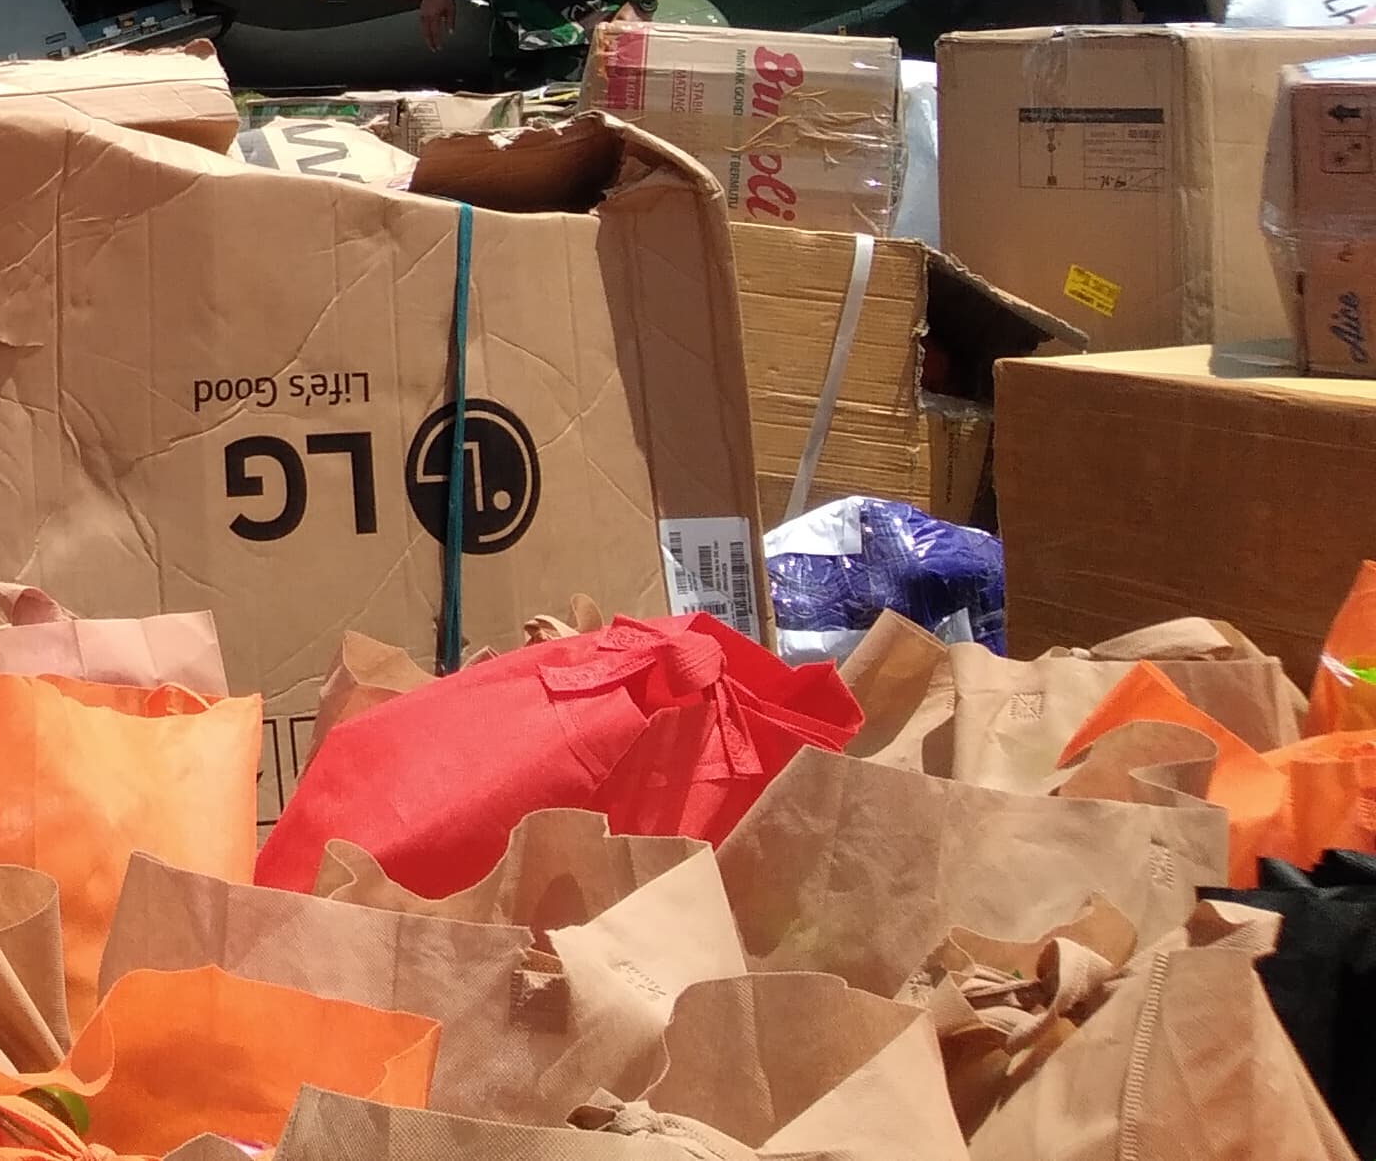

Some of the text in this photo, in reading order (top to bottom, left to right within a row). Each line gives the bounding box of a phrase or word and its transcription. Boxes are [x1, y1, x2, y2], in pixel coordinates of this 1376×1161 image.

[733, 48, 747, 85] MINYAK
[727, 161, 742, 210] BERMUTU
[193, 371, 371, 412] Life's Good
[224, 431, 378, 542] LG
